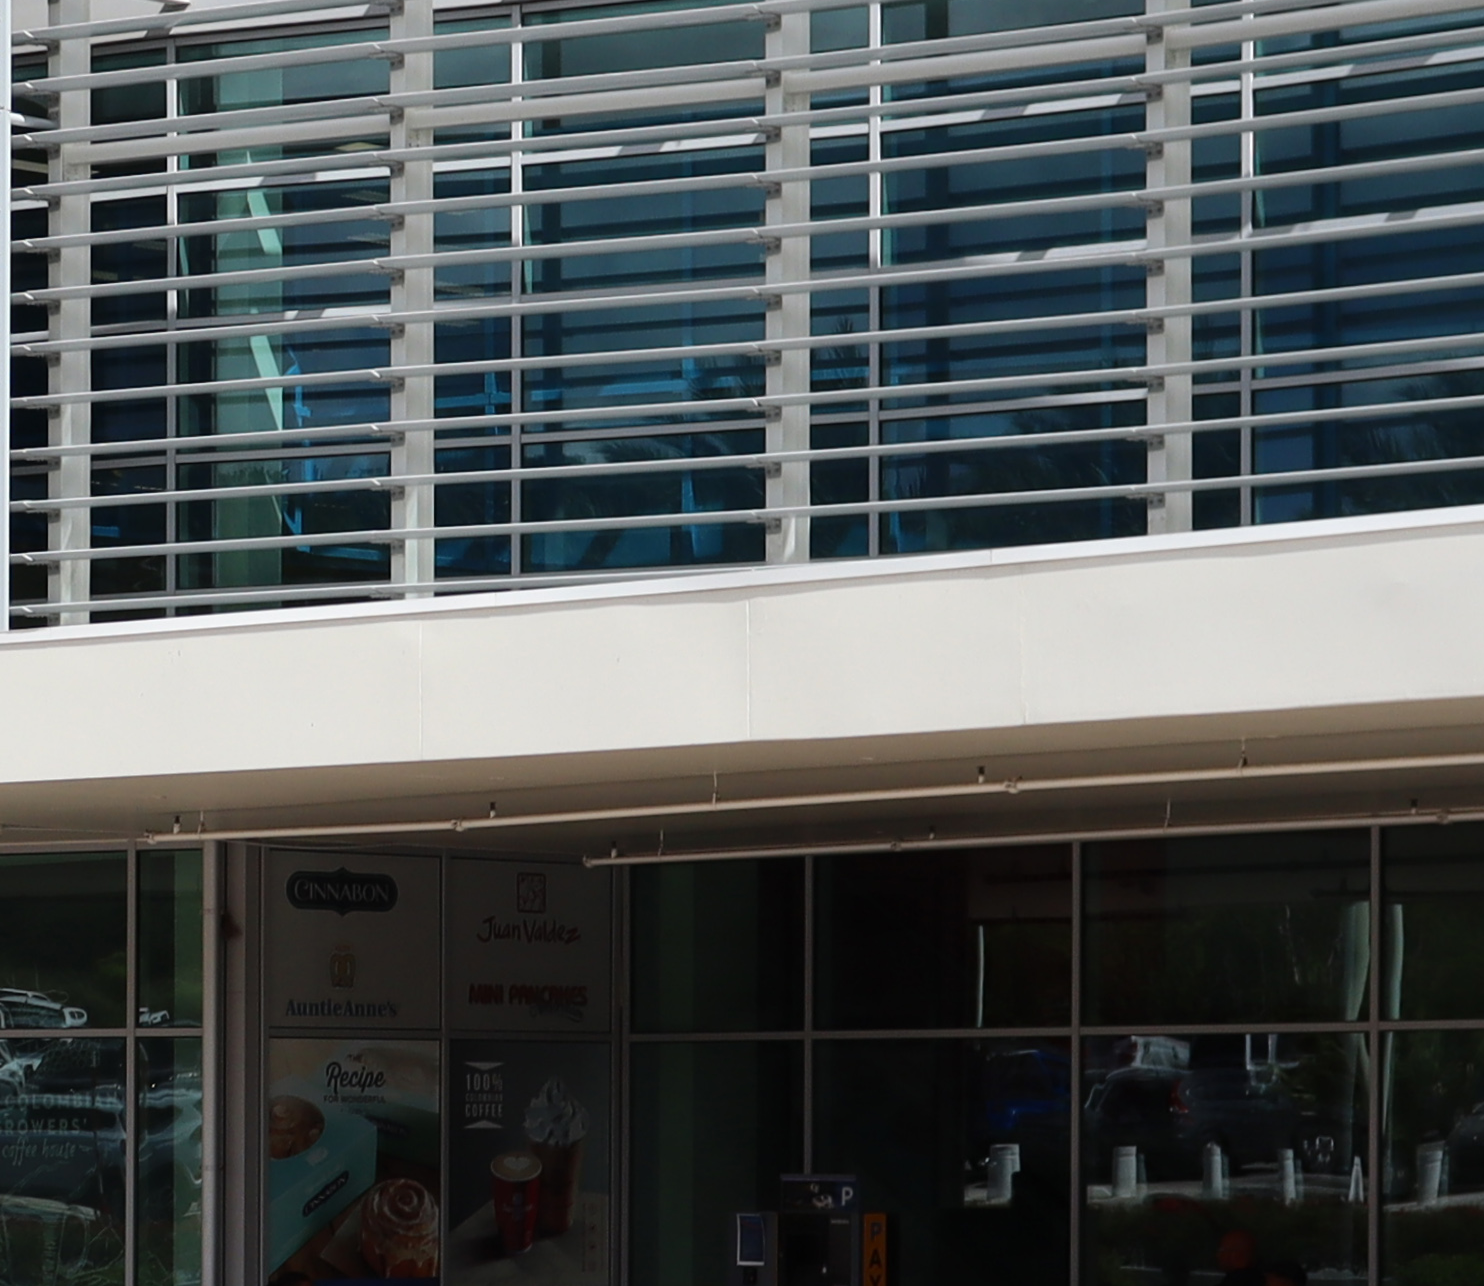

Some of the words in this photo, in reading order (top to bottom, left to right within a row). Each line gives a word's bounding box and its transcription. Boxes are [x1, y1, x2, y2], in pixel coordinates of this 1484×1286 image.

[294, 878, 390, 904] CINNABON
[477, 915, 521, 943] Juan
[523, 919, 581, 945] Valdez
[469, 983, 504, 1004] MINI
[326, 1062, 386, 1095] Recipe
[465, 1073, 503, 1092] 100%
[465, 1103, 503, 1118] COFFEE
[841, 1186, 854, 1206] P
